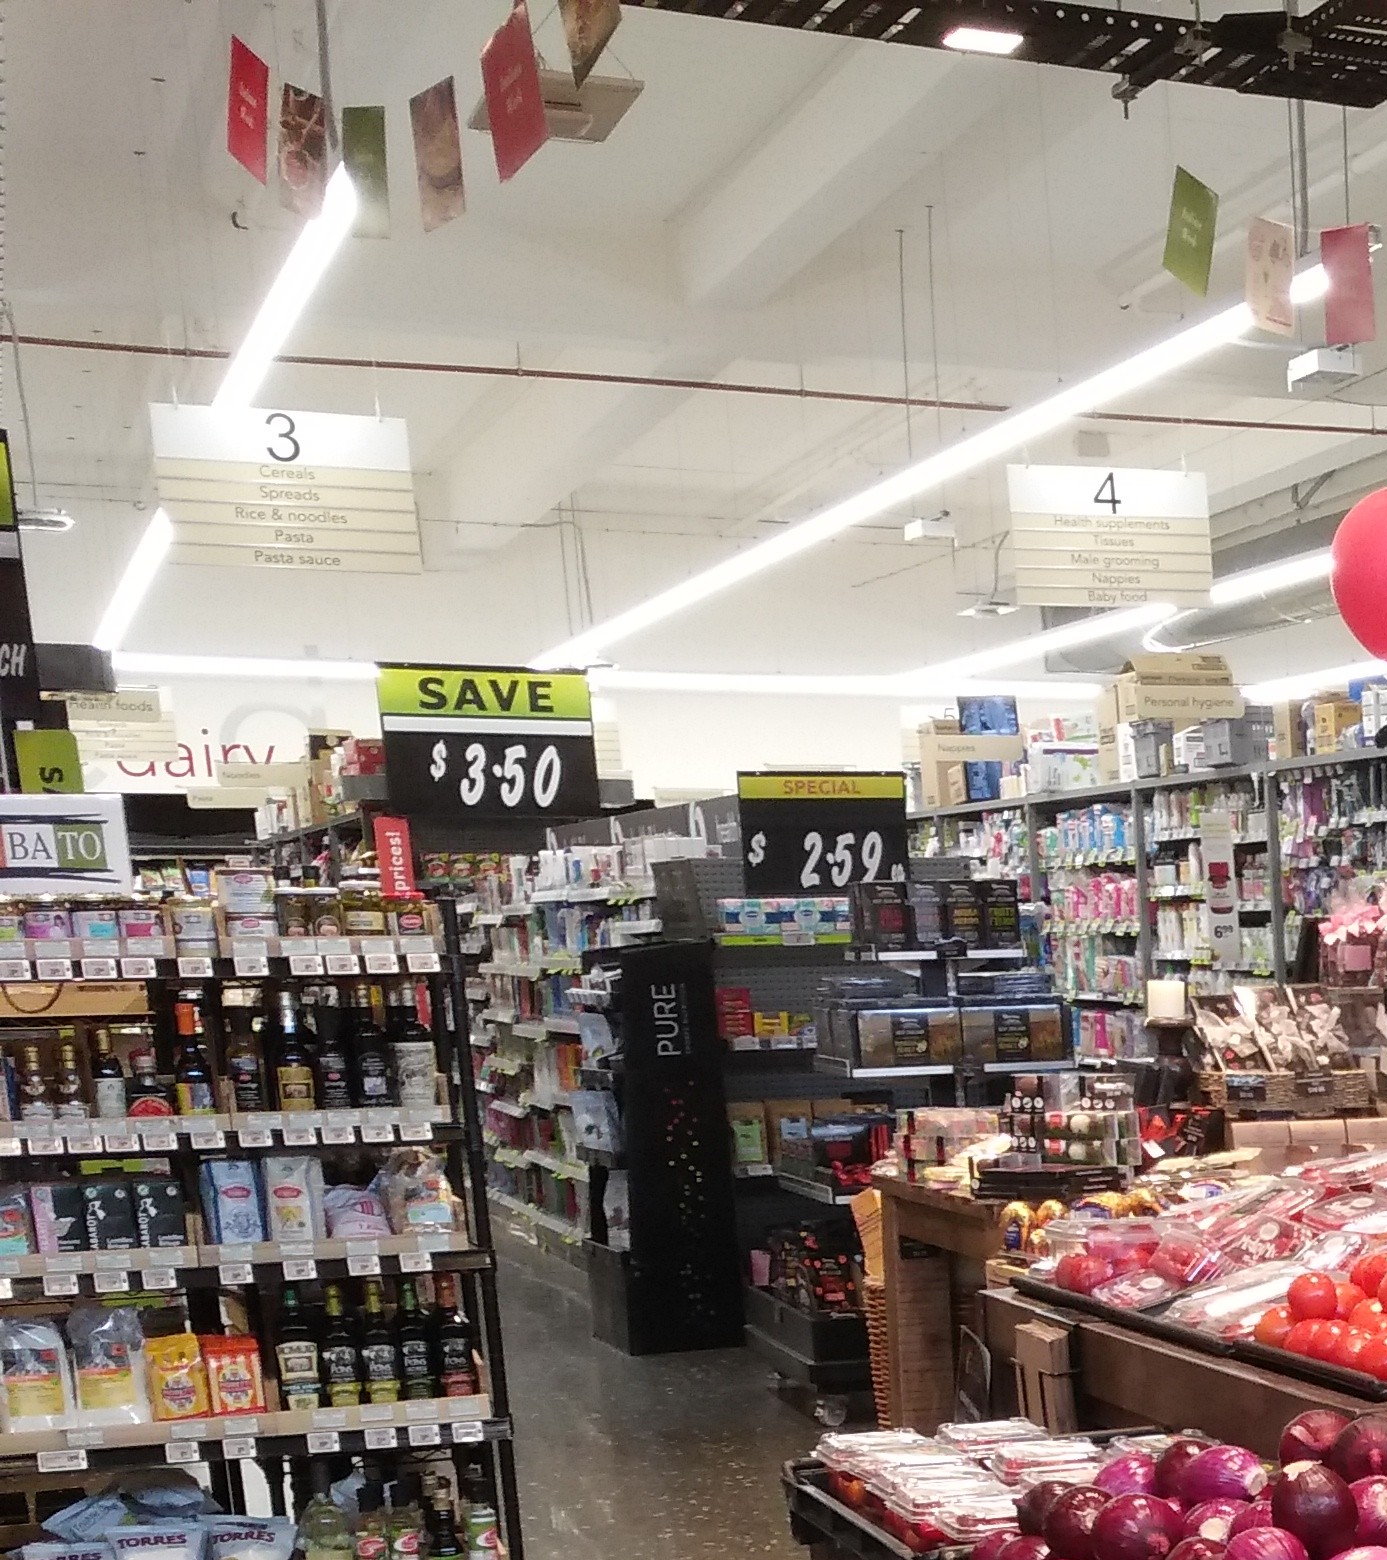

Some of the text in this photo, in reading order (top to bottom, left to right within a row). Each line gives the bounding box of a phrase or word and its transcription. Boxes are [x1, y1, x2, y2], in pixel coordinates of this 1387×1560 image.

[265, 413, 301, 463] 3
[259, 464, 316, 480] Cereals
[260, 486, 320, 502] Spreads
[1093, 472, 1122, 514] 4
[235, 506, 348, 525] Rice & noodles
[1054, 516, 1170, 531] Health supplements
[275, 529, 314, 544] Pasta
[1093, 535, 1135, 546] Tissues
[254, 550, 341, 567] Pasta sauce
[1071, 553, 1160, 570] Male grooming
[1092, 572, 1141, 585] Nappies
[1088, 590, 1148, 603] Baby food
[418, 675, 555, 713] SAVE
[116, 698, 153, 713] foods
[1144, 696, 1234, 711] Personal hygiene
[783, 779, 861, 796] SPECIAL
[650, 981, 683, 1058] PURE
[118, 1533, 187, 1549] TORRES
[213, 1530, 276, 1545] TORRES
